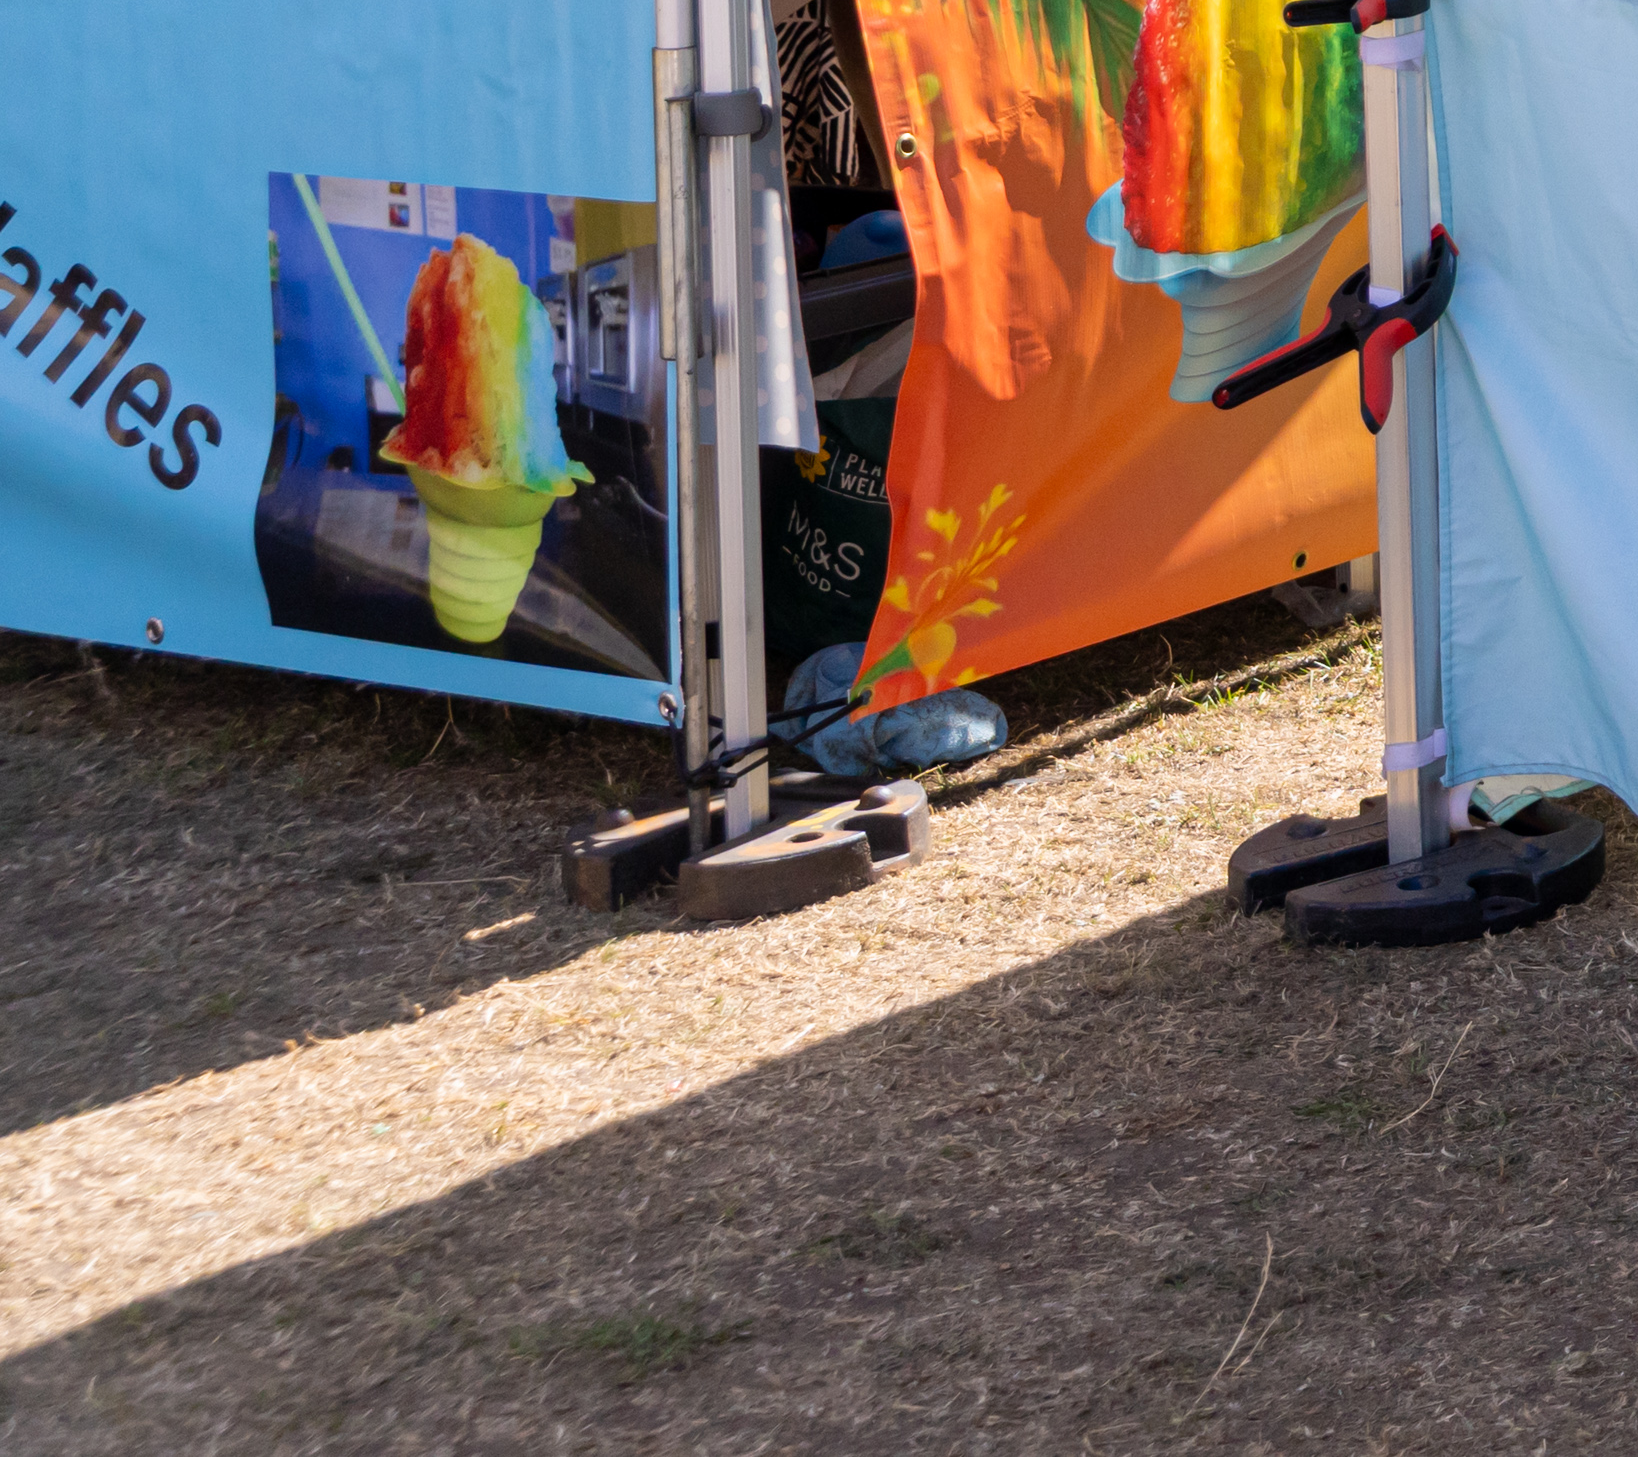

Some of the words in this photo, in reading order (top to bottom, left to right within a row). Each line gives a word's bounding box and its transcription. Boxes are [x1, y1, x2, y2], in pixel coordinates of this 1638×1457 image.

[0, 200, 222, 490] affles
[788, 500, 864, 581] M&S
[792, 555, 831, 592] FOOD
